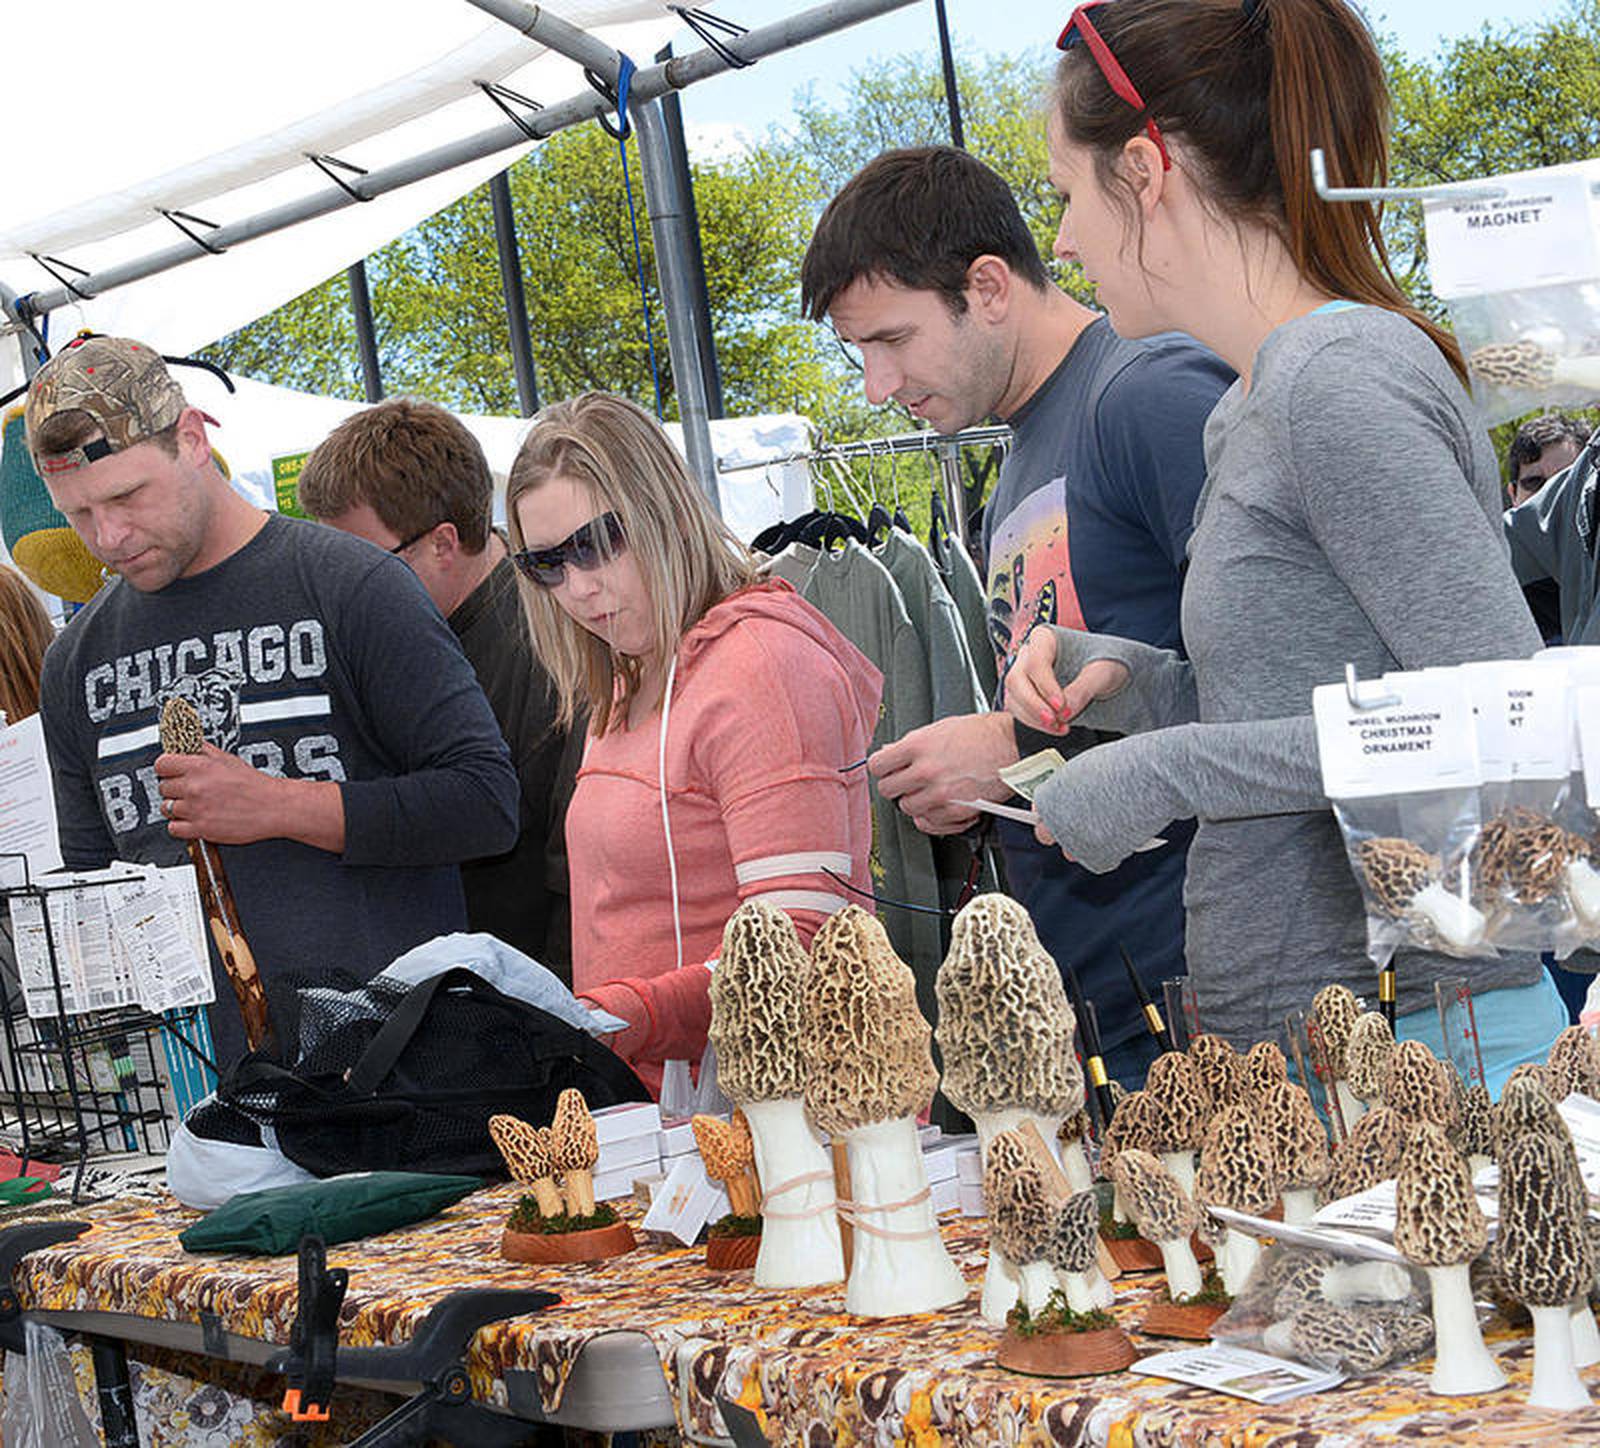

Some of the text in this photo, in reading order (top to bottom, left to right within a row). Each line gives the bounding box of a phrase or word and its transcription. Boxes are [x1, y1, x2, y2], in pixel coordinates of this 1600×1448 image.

[1467, 209, 1541, 229] MAGNET
[85, 620, 328, 723] CHICAGO
[1386, 713, 1441, 724] MUSHROOM
[1360, 725, 1433, 740] CHRISTMAS
[1362, 740, 1432, 755] ORNAMENT
